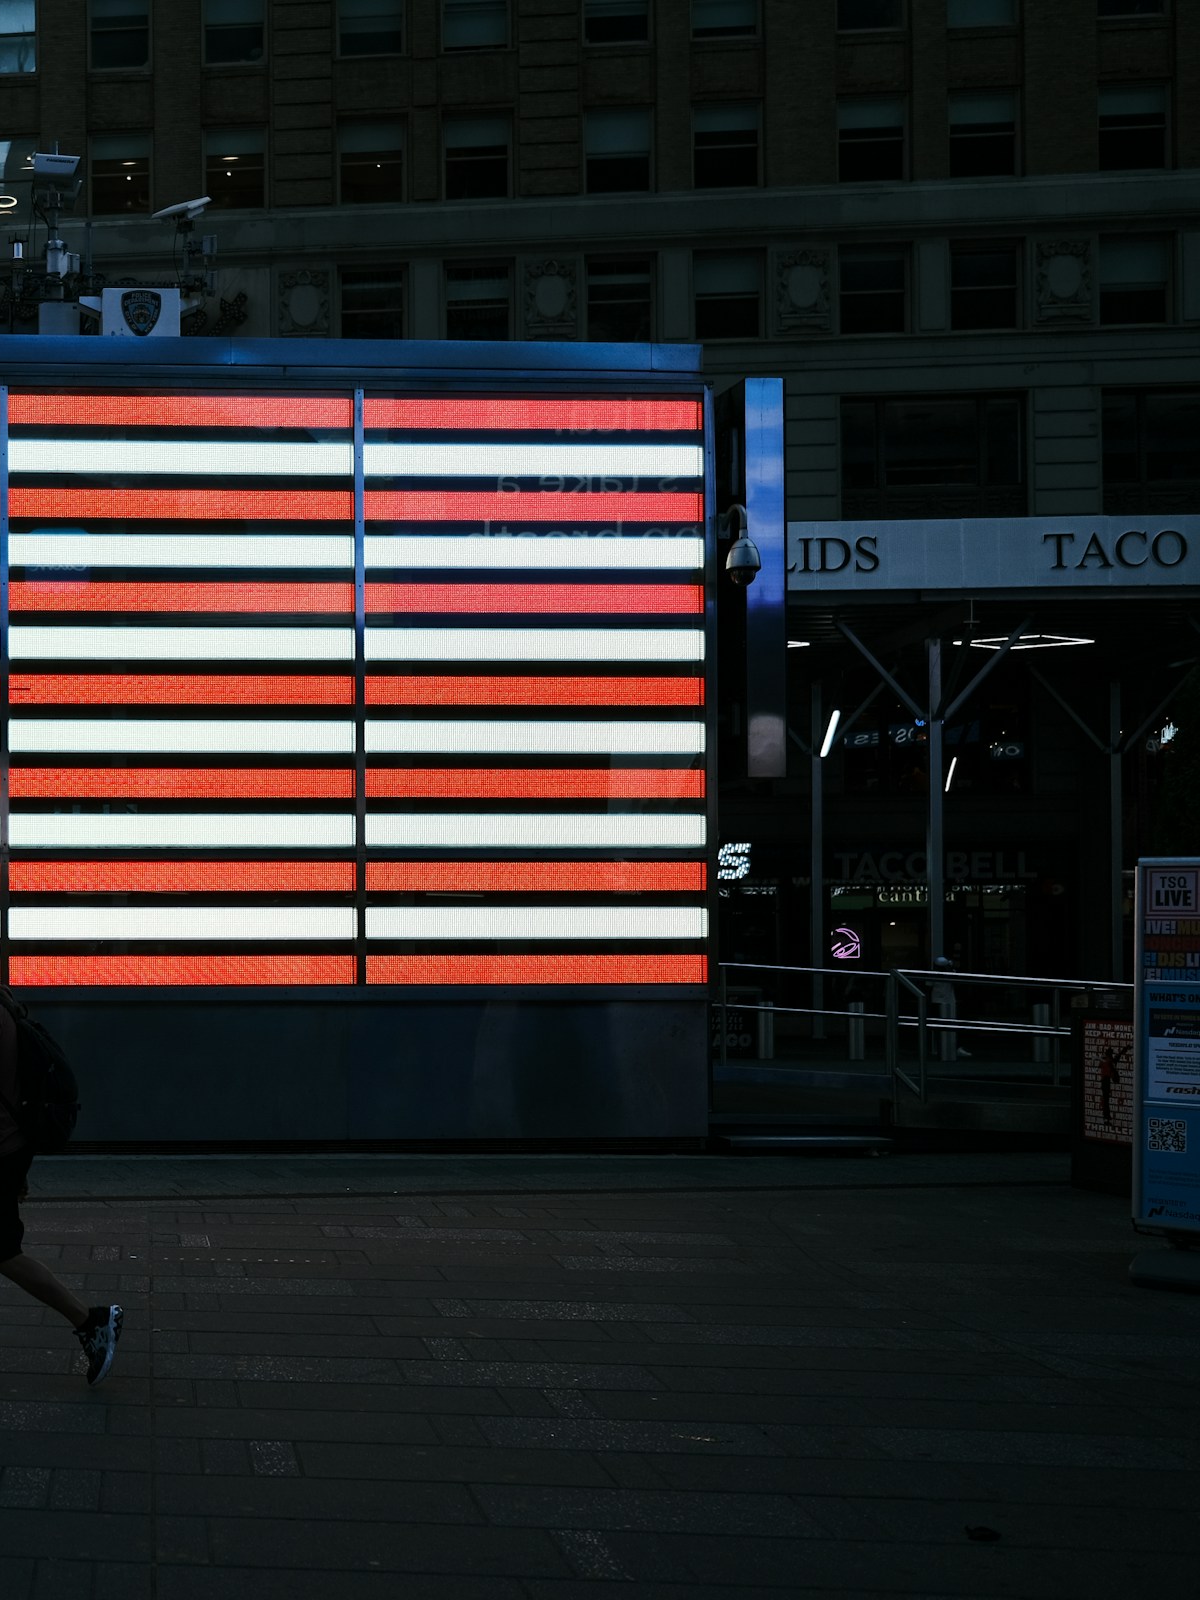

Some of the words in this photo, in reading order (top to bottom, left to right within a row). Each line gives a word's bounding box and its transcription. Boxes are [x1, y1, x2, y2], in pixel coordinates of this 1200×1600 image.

[1042, 529, 1189, 570] TACO
[833, 851, 928, 880] TACO
[946, 851, 1038, 880] BELL
[1159, 876, 1187, 889] TSQ
[1155, 890, 1192, 906] LIVE
[1144, 920, 1176, 935] IVE!
[1149, 992, 1186, 1002] WHAT'S
